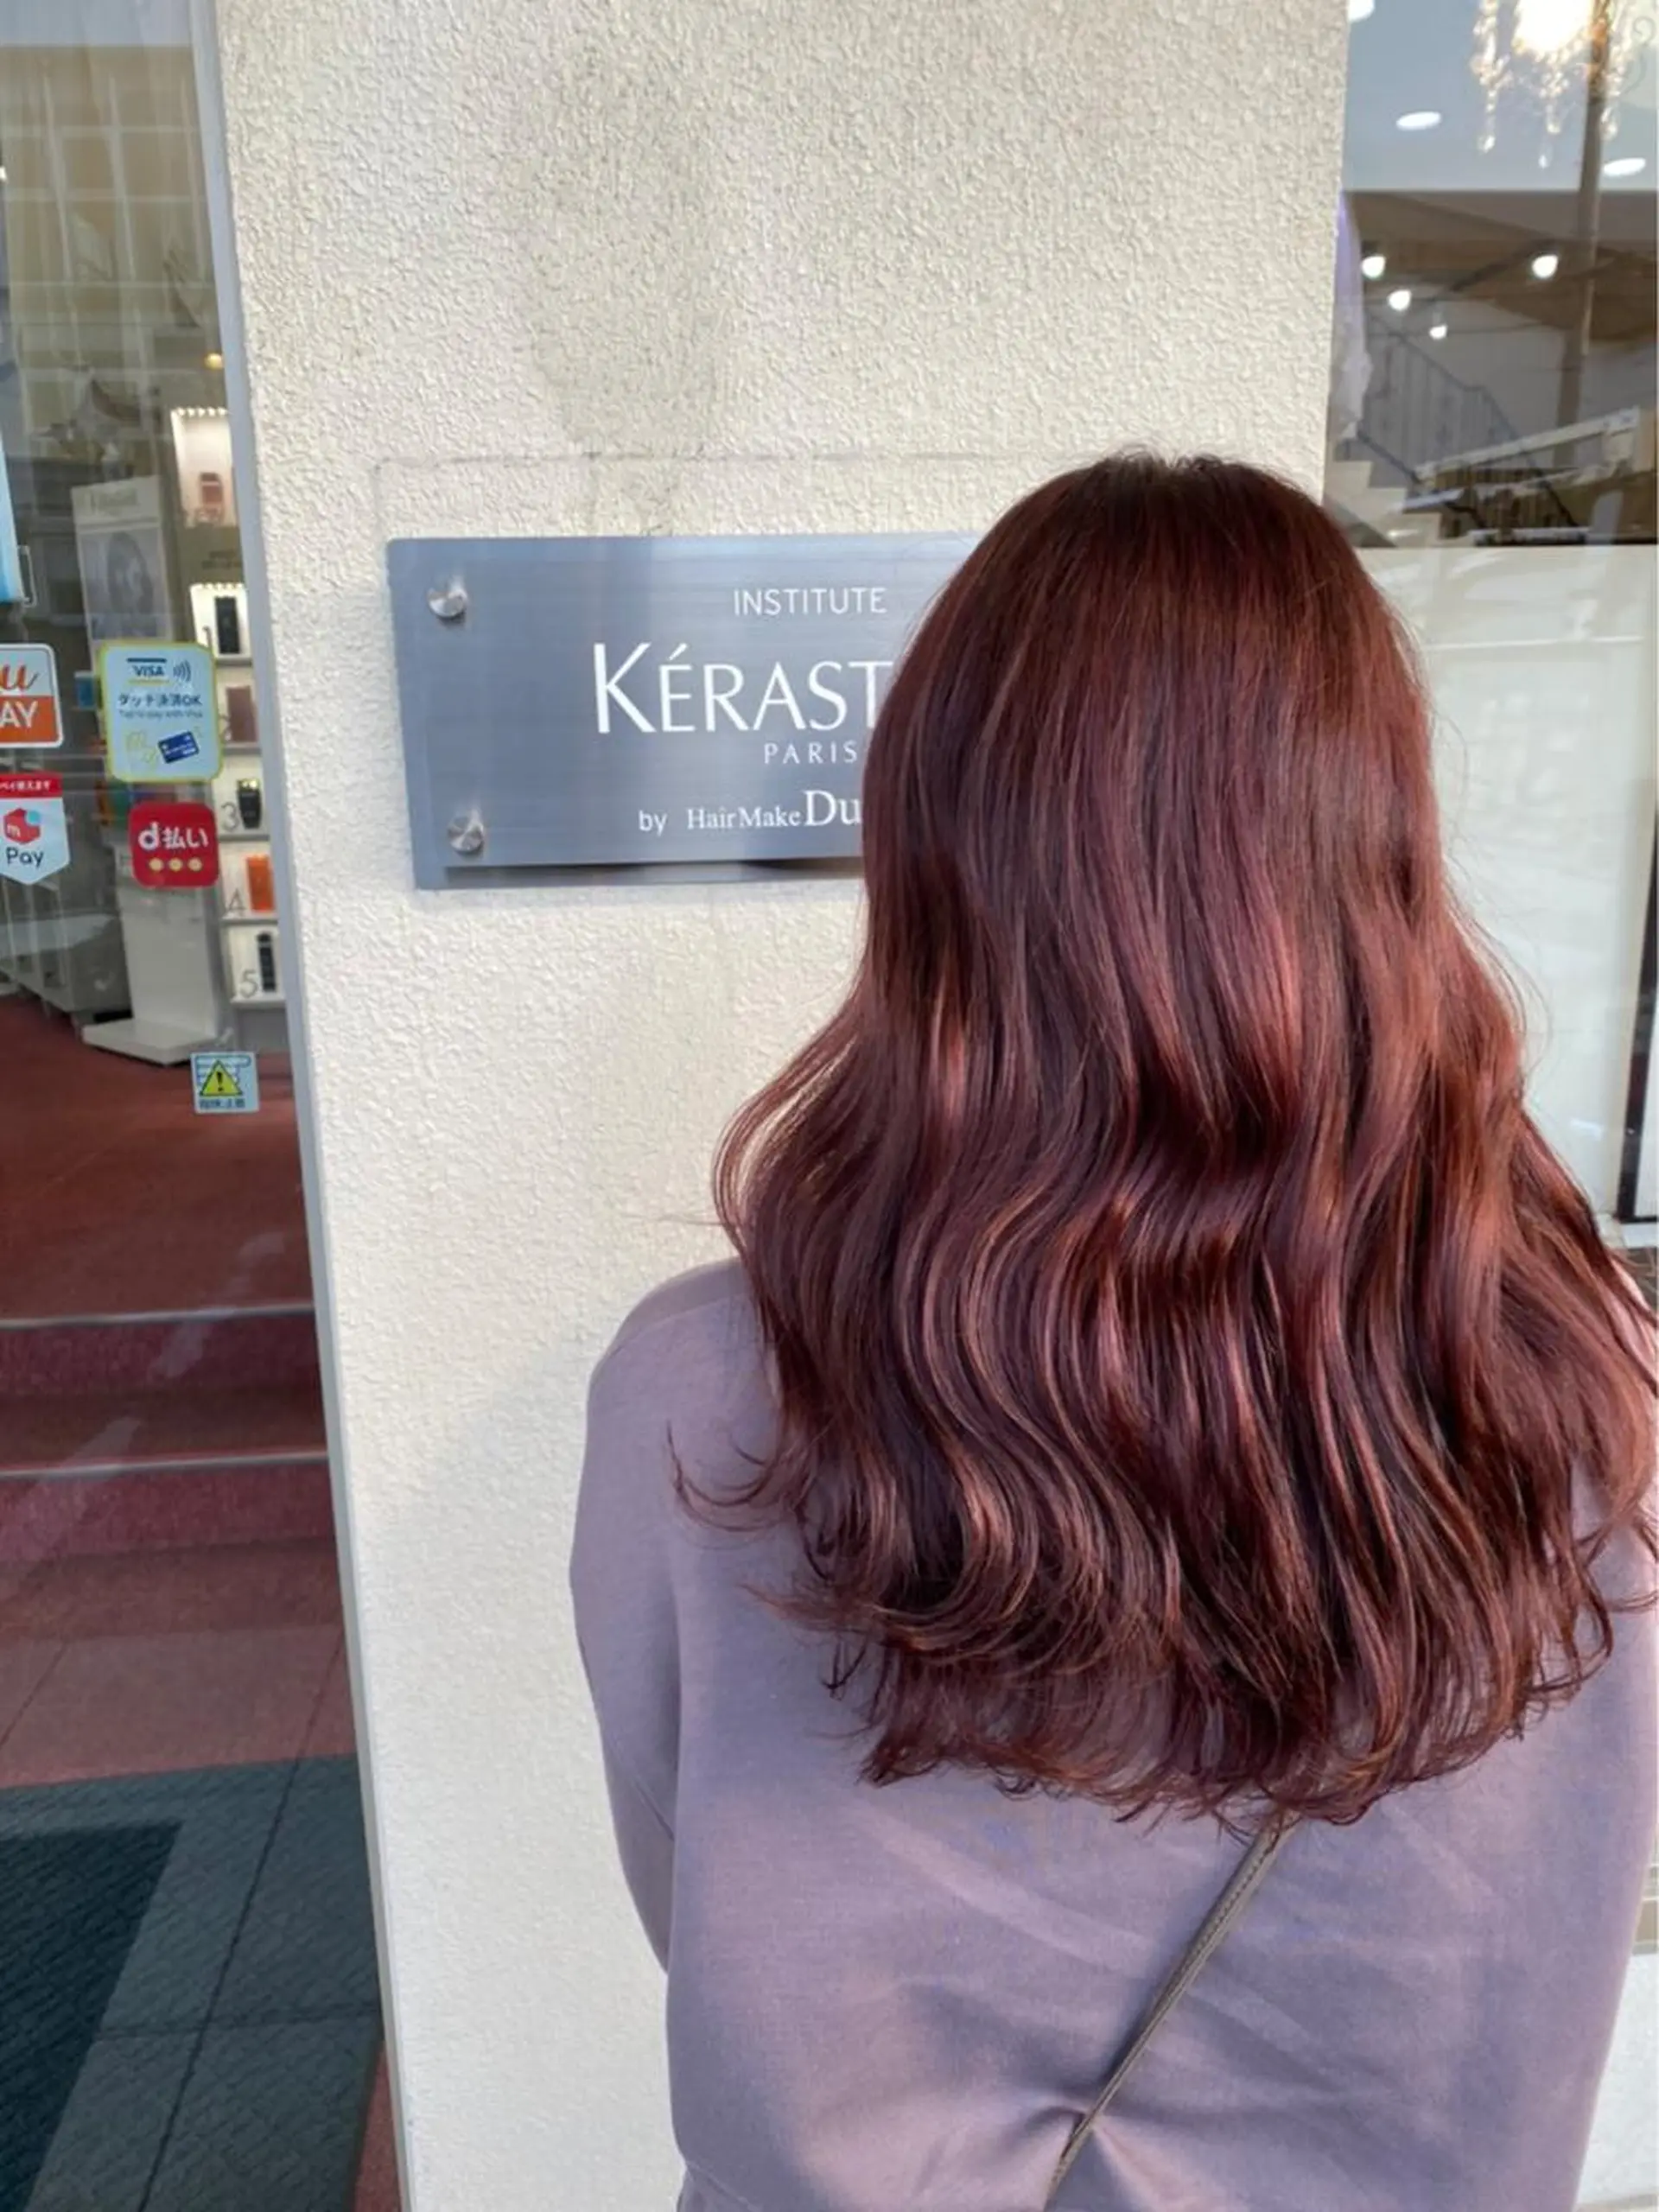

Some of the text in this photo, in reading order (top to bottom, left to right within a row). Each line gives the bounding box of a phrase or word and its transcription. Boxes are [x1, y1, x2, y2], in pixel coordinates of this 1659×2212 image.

[734, 587, 887, 617] INSTITUTE
[132, 664, 165, 677] VISA
[764, 741, 857, 765] PARIS
[220, 802, 238, 831] 3
[638, 810, 667, 836] by
[137, 820, 209, 851] d払い
[5, 847, 44, 868] Pay
